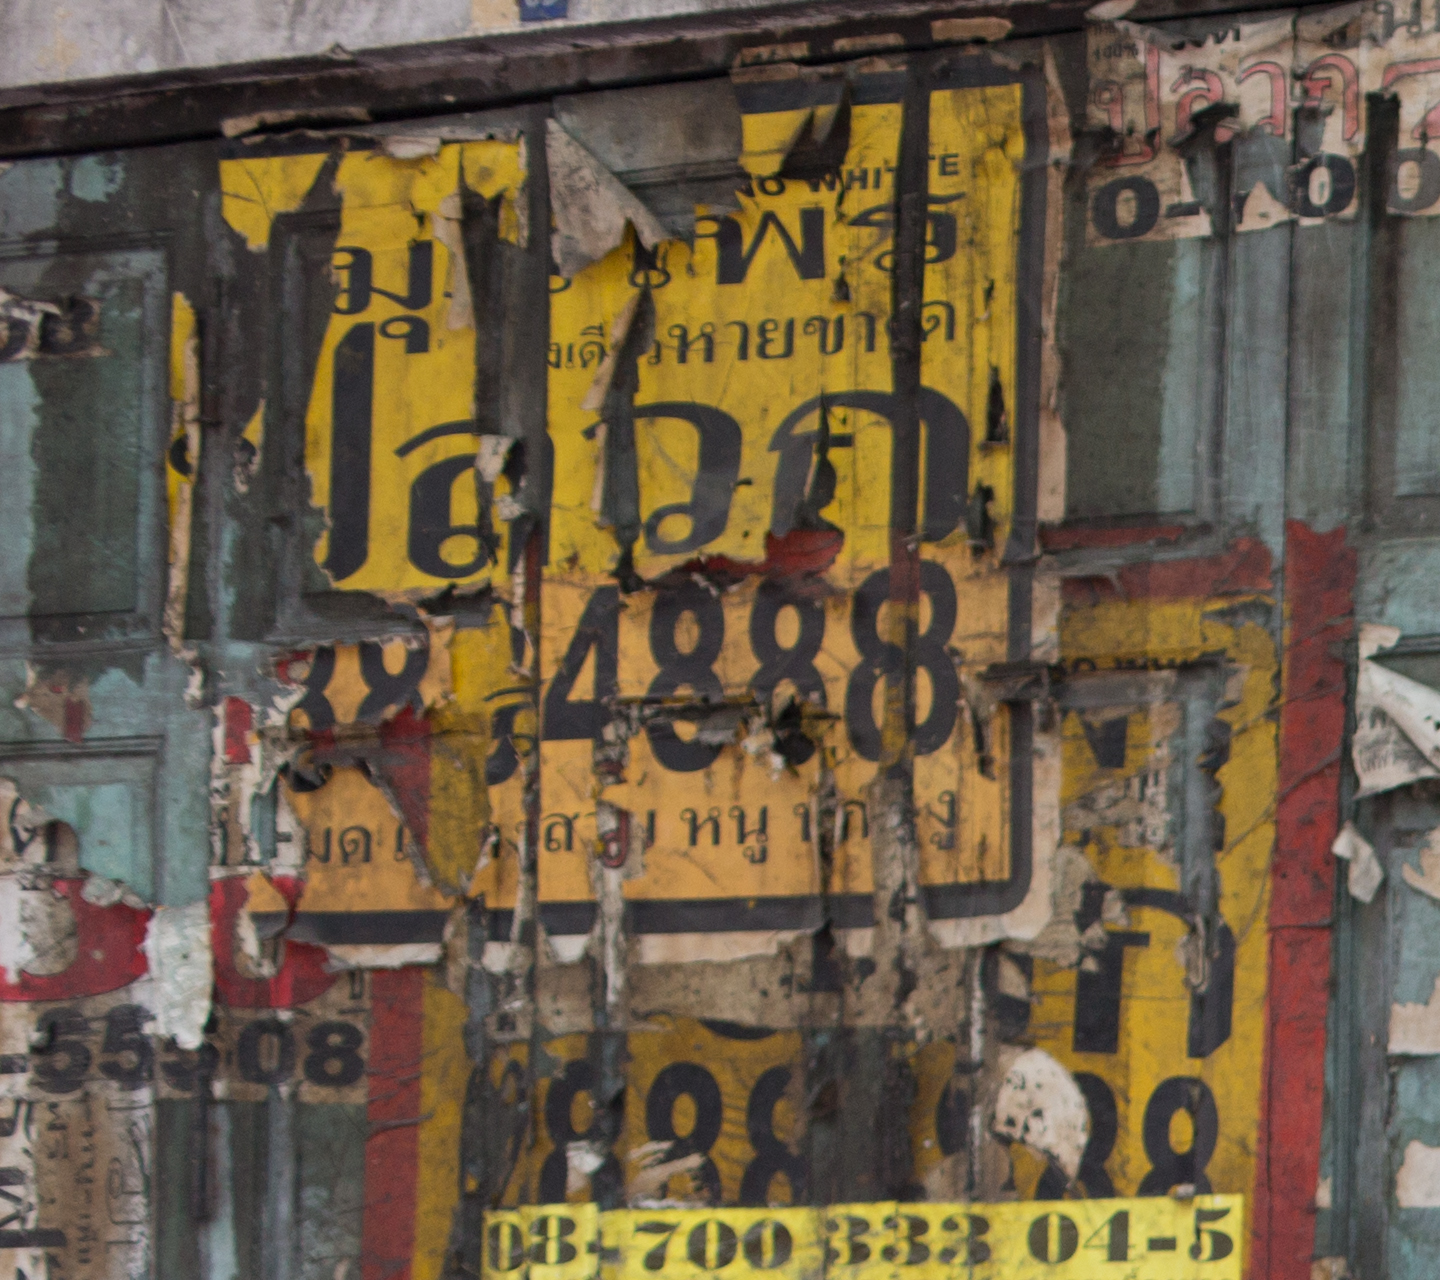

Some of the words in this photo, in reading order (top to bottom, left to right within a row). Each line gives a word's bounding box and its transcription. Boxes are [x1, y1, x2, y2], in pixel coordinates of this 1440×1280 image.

[488, 1215, 792, 1272] 08-700
[825, 1212, 992, 1266] 333
[1027, 1208, 1234, 1264] 04-5
